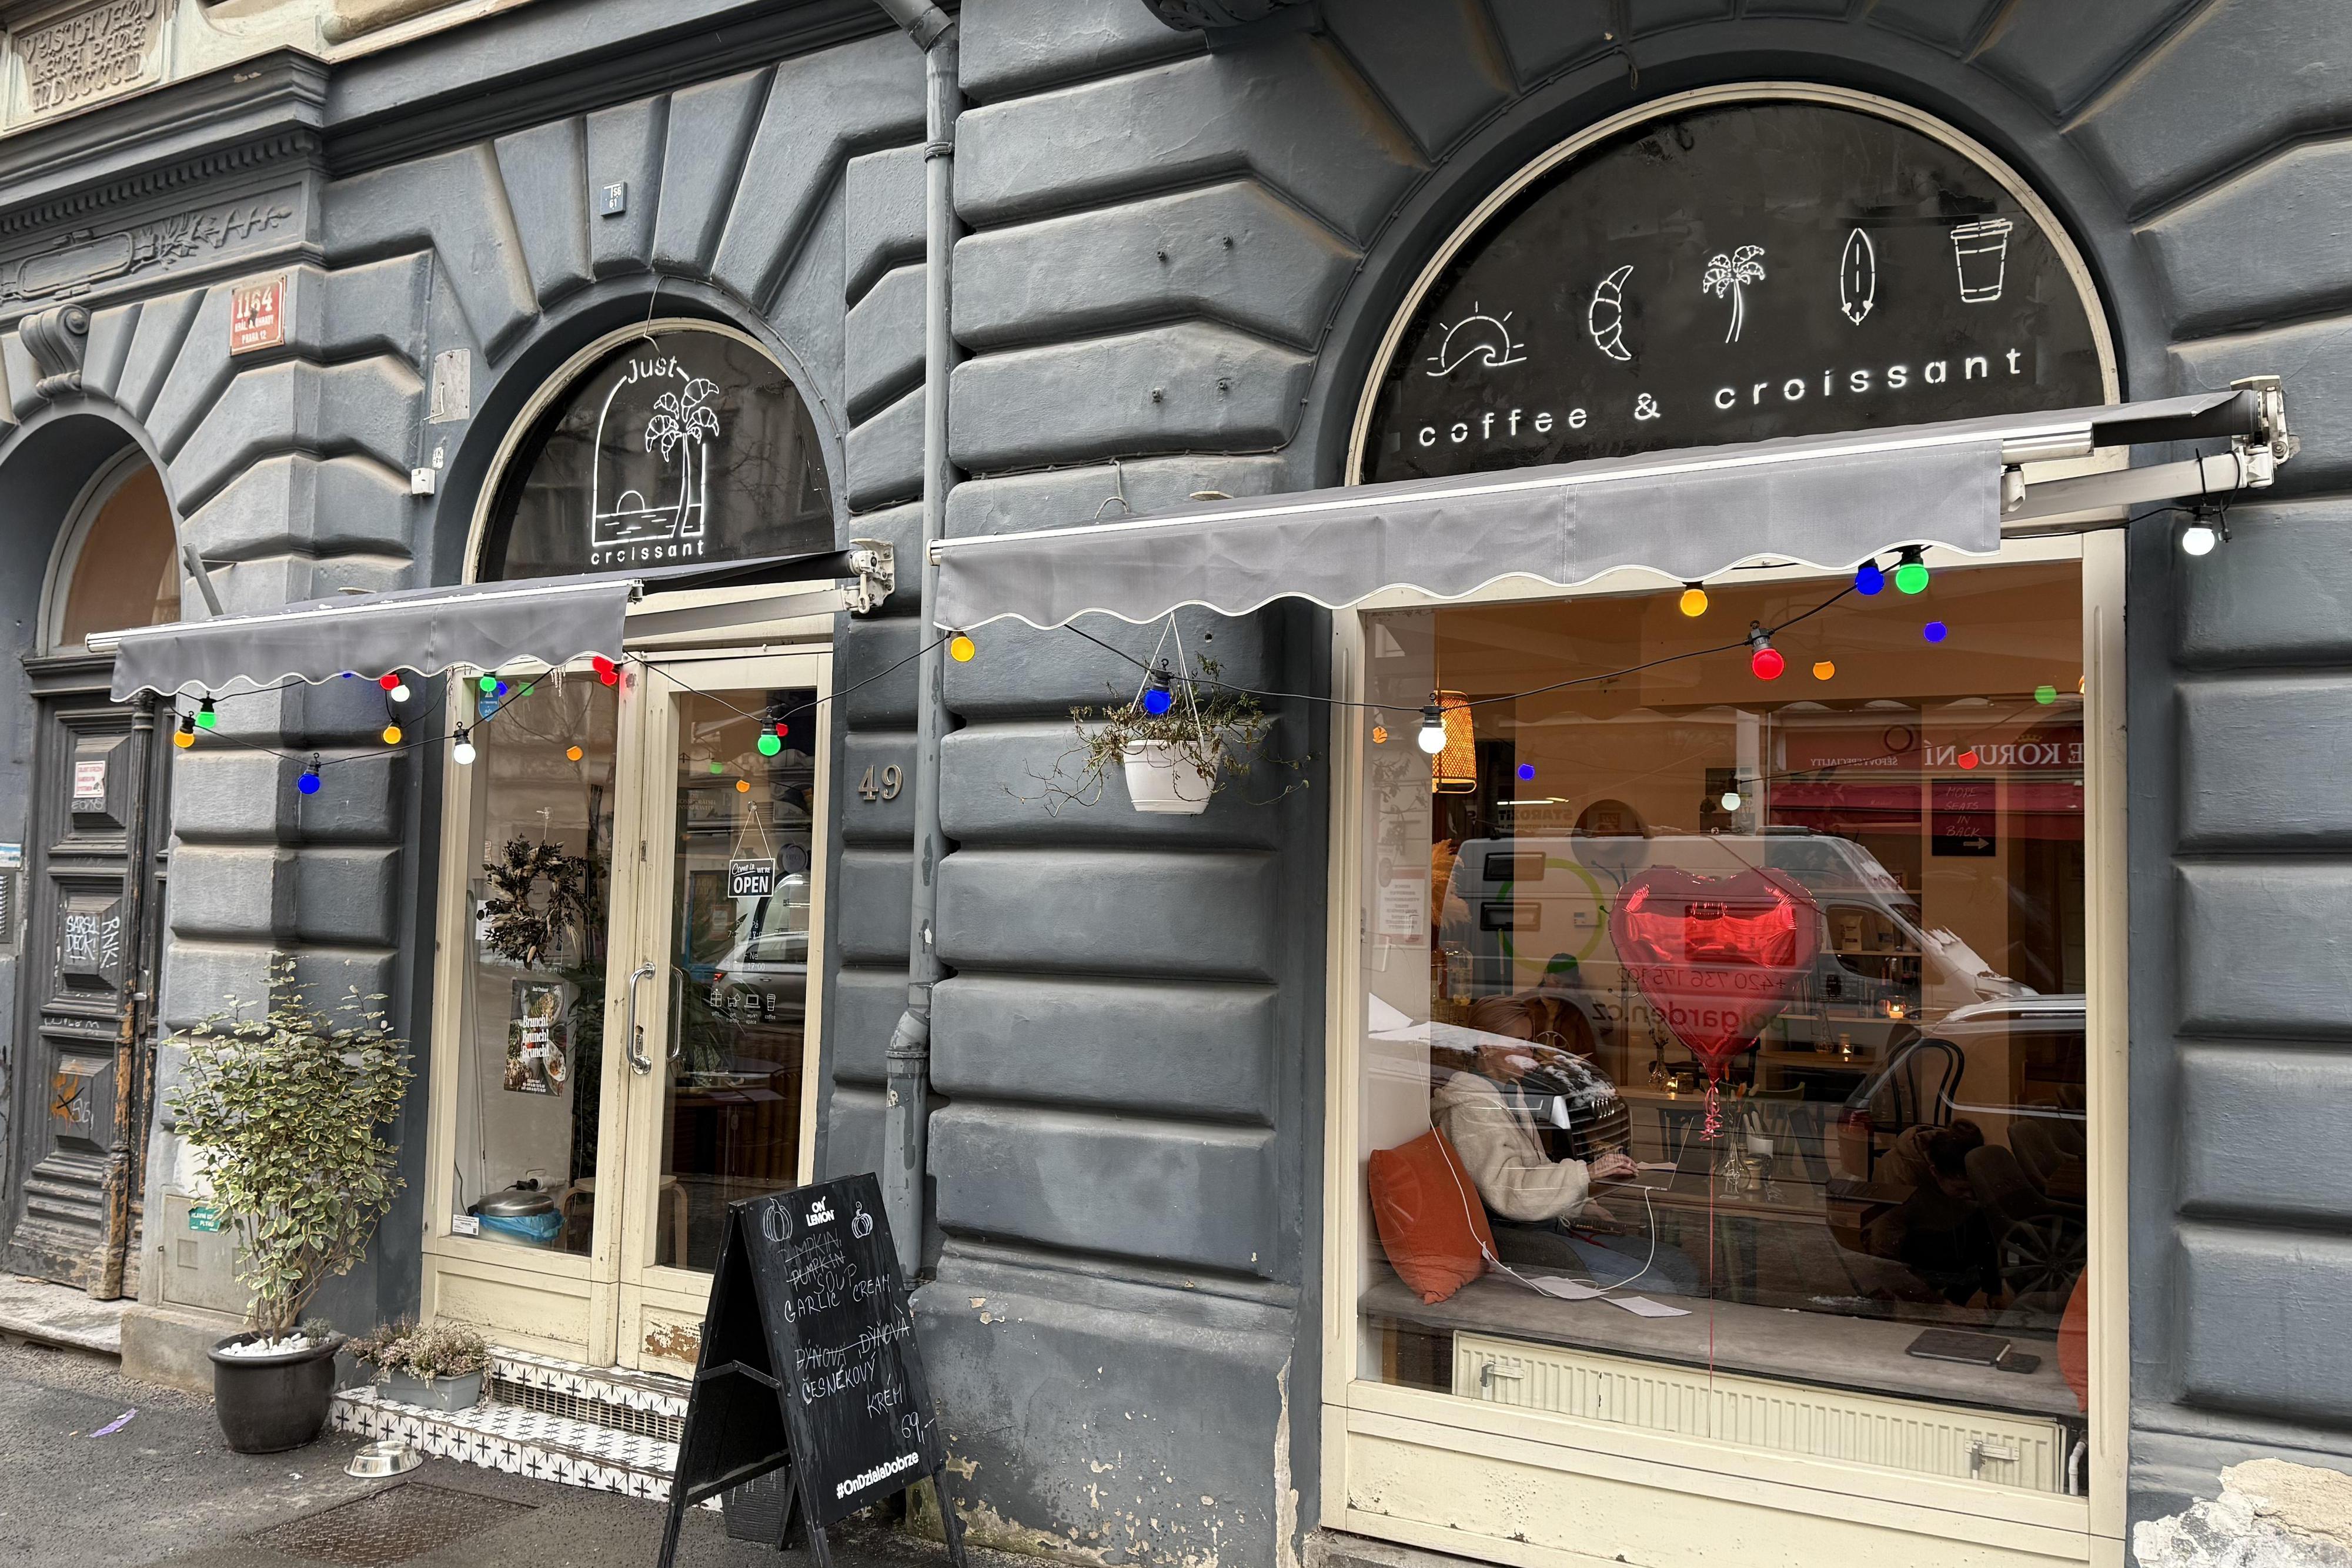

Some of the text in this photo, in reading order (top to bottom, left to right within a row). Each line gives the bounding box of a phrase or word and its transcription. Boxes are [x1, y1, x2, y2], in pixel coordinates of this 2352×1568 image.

[236, 286, 273, 319] 1164
[627, 355, 679, 385] Just
[1418, 347, 2022, 447] coffee & croissant
[590, 539, 705, 566] croissant
[858, 764, 902, 800] 49
[1945, 786, 1980, 798] MORE
[1944, 801, 1979, 811] SEATS
[1957, 815, 1970, 824] IN
[1946, 825, 1982, 837] BACK
[733, 875, 769, 894] OPEN
[522, 1013, 549, 1028] Brunch!
[522, 1028, 549, 1043] Brunch!
[522, 1044, 550, 1058] Brunch!
[811, 1197, 826, 1213] ON
[806, 1209, 835, 1228] LEMON
[813, 1263, 857, 1295] SOUP
[784, 1273, 891, 1323] GARLIC CREAM
[867, 1373, 903, 1419] KRÉM
[836, 1451, 920, 1500] #OnDzialaDobrze
